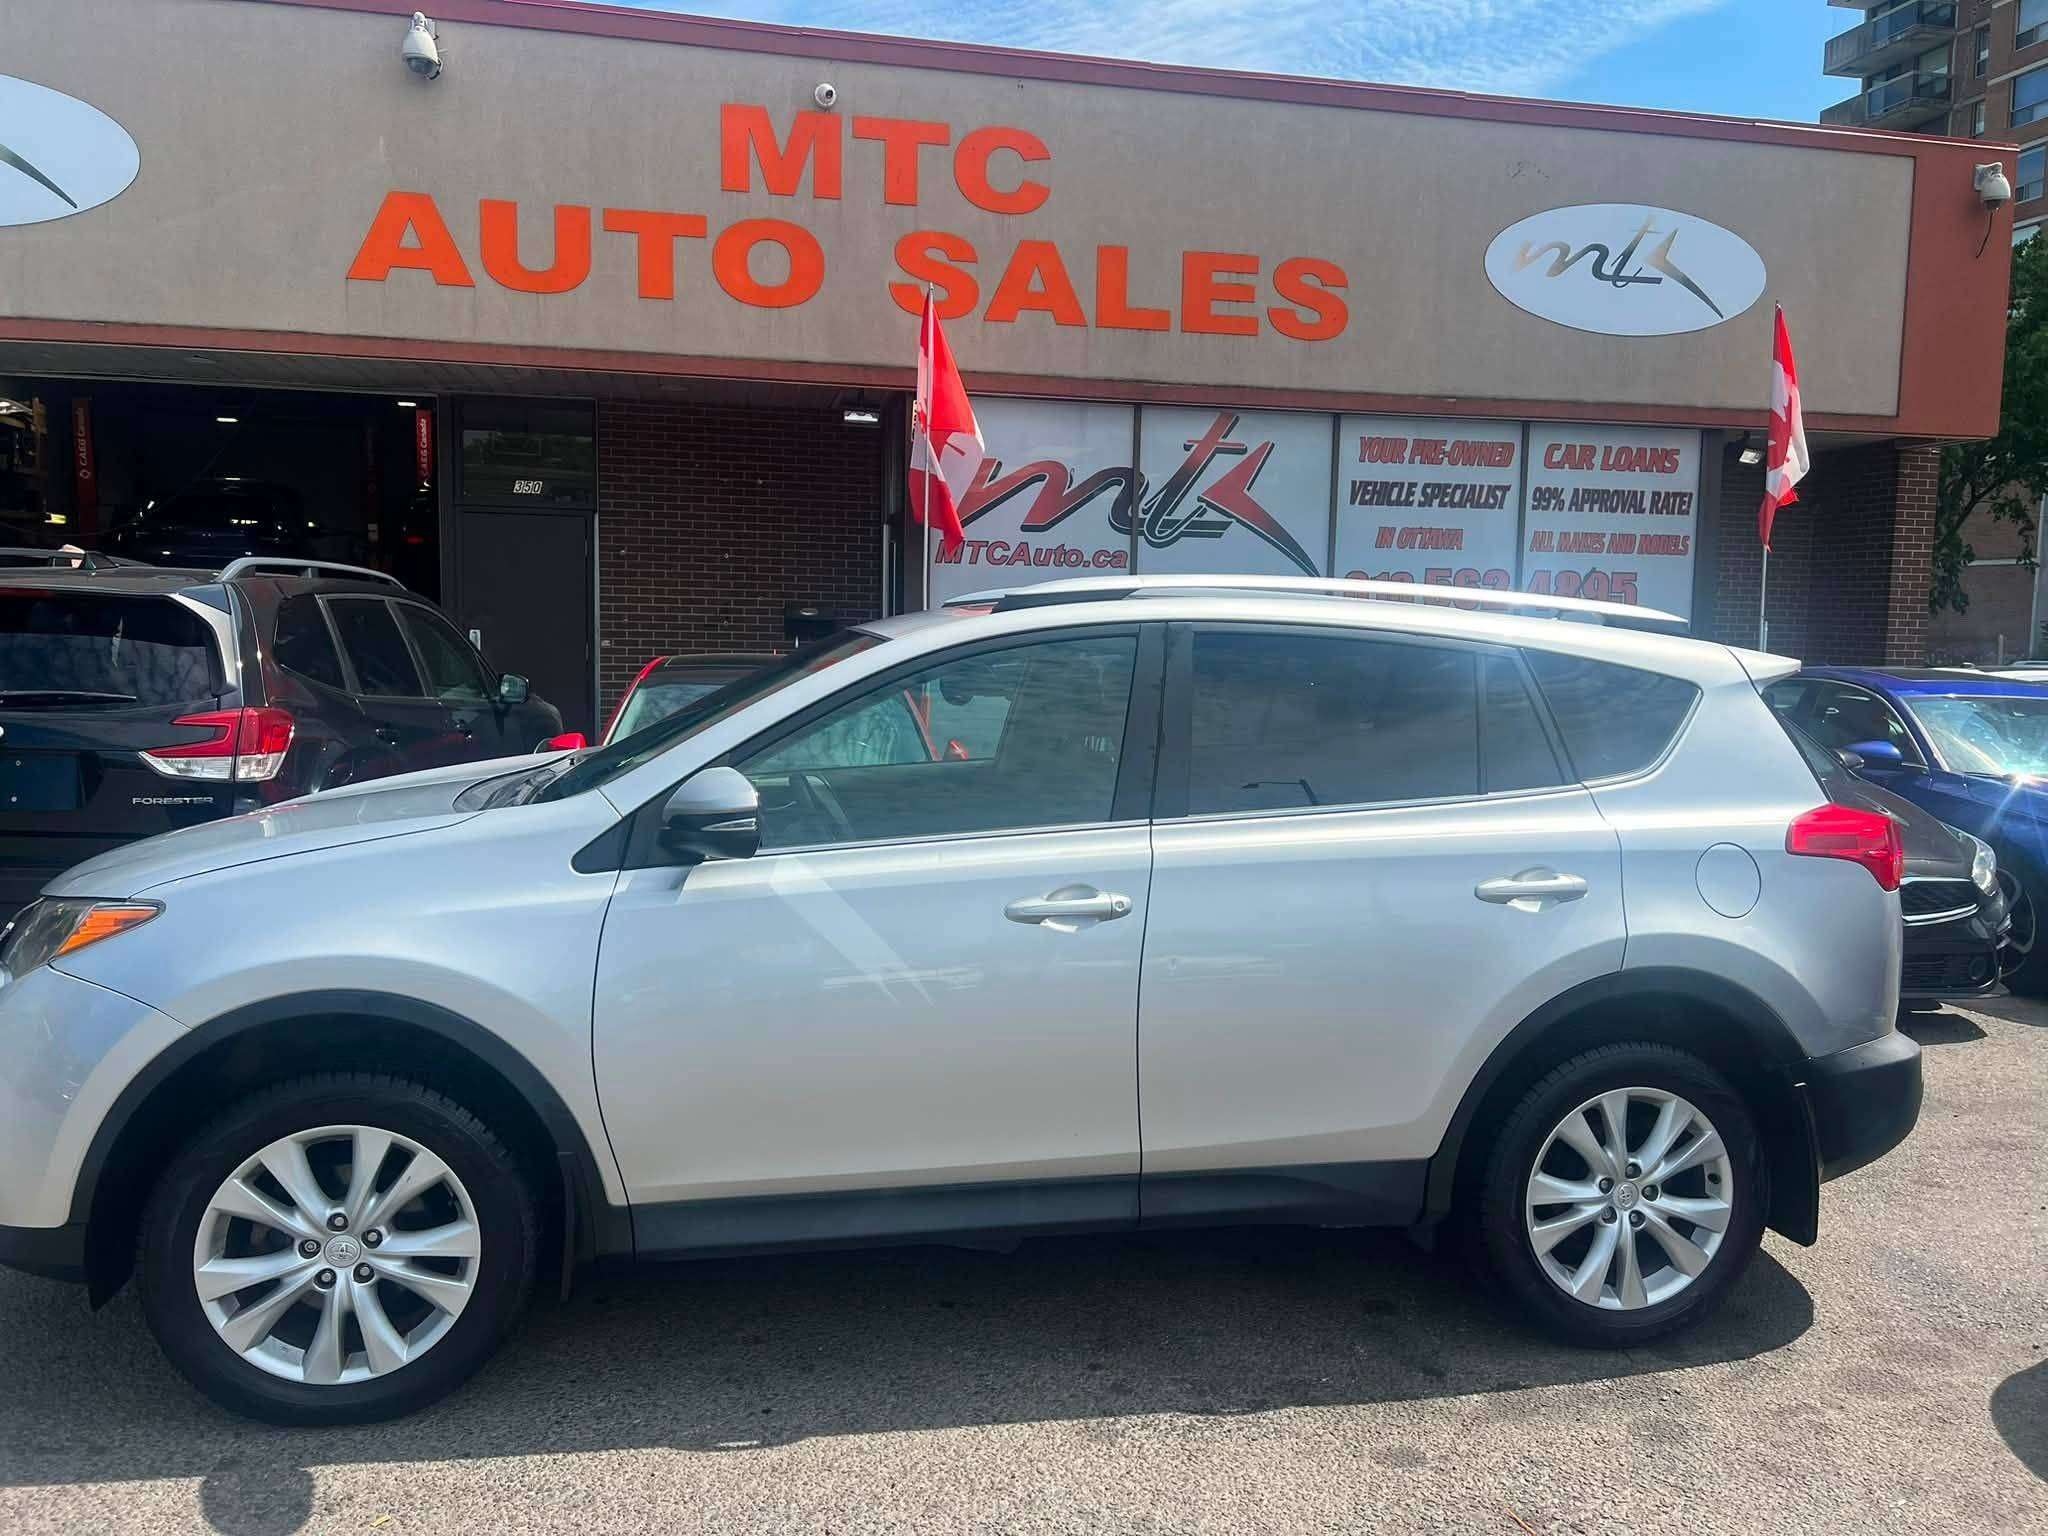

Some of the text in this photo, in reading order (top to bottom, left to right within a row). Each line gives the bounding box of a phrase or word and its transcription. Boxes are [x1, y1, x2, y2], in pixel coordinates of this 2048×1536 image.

[720, 104, 1051, 214] MTC
[348, 191, 1348, 341] AUTO SALES
[1359, 437, 1515, 468] YOUR PRE-OWNED
[1544, 443, 1680, 473] CAR LOANS
[513, 480, 543, 494] 350
[1350, 480, 1512, 509] VEHICLE SPECIALIST
[1532, 487, 1694, 516] 99% APPROVAL RATE!
[1375, 527, 1464, 550] IN OTTAWA
[1530, 531, 1691, 556] ALL MAKES AND MODELS
[935, 540, 1128, 568] MTCAuto.ca
[132, 797, 214, 805] FORESTER
